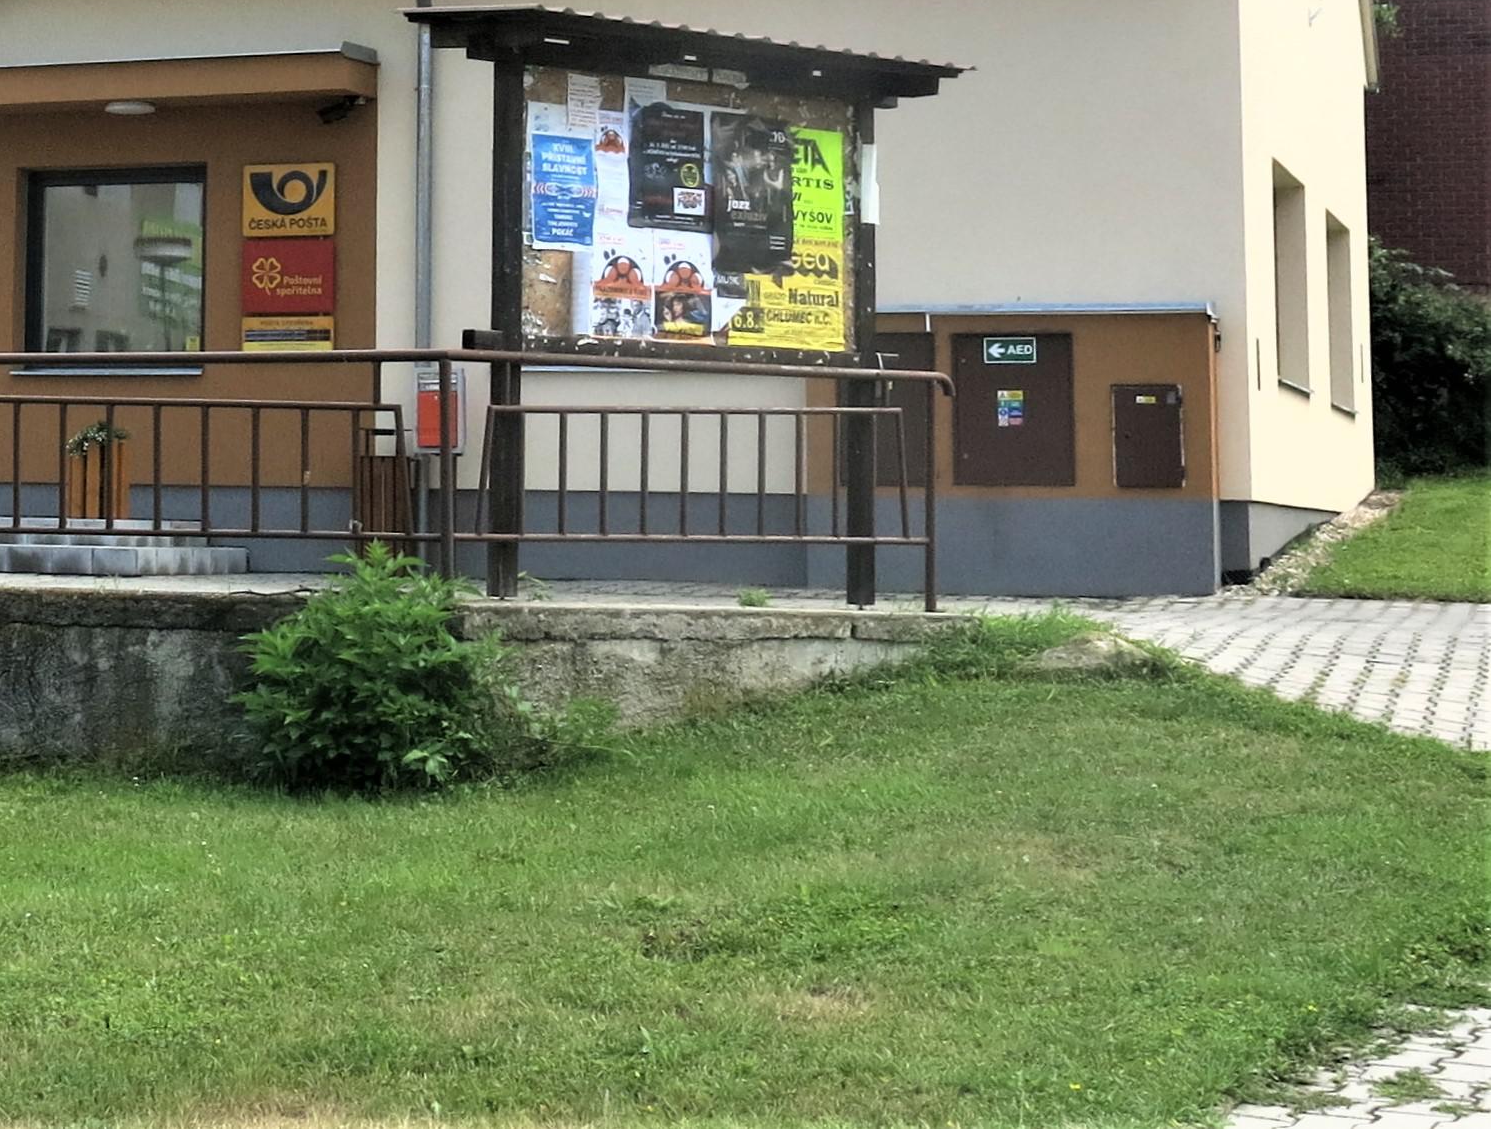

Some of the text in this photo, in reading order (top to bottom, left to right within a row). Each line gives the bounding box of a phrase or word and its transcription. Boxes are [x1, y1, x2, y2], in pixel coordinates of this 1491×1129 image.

[792, 176, 835, 190] RTIS
[726, 199, 751, 212] jazz
[248, 216, 327, 230] ČESKÁ POŠTA
[283, 274, 323, 285] Poštovní
[276, 285, 323, 297] spořitelna
[788, 288, 839, 307] Natural
[1007, 344, 1033, 355] AED
